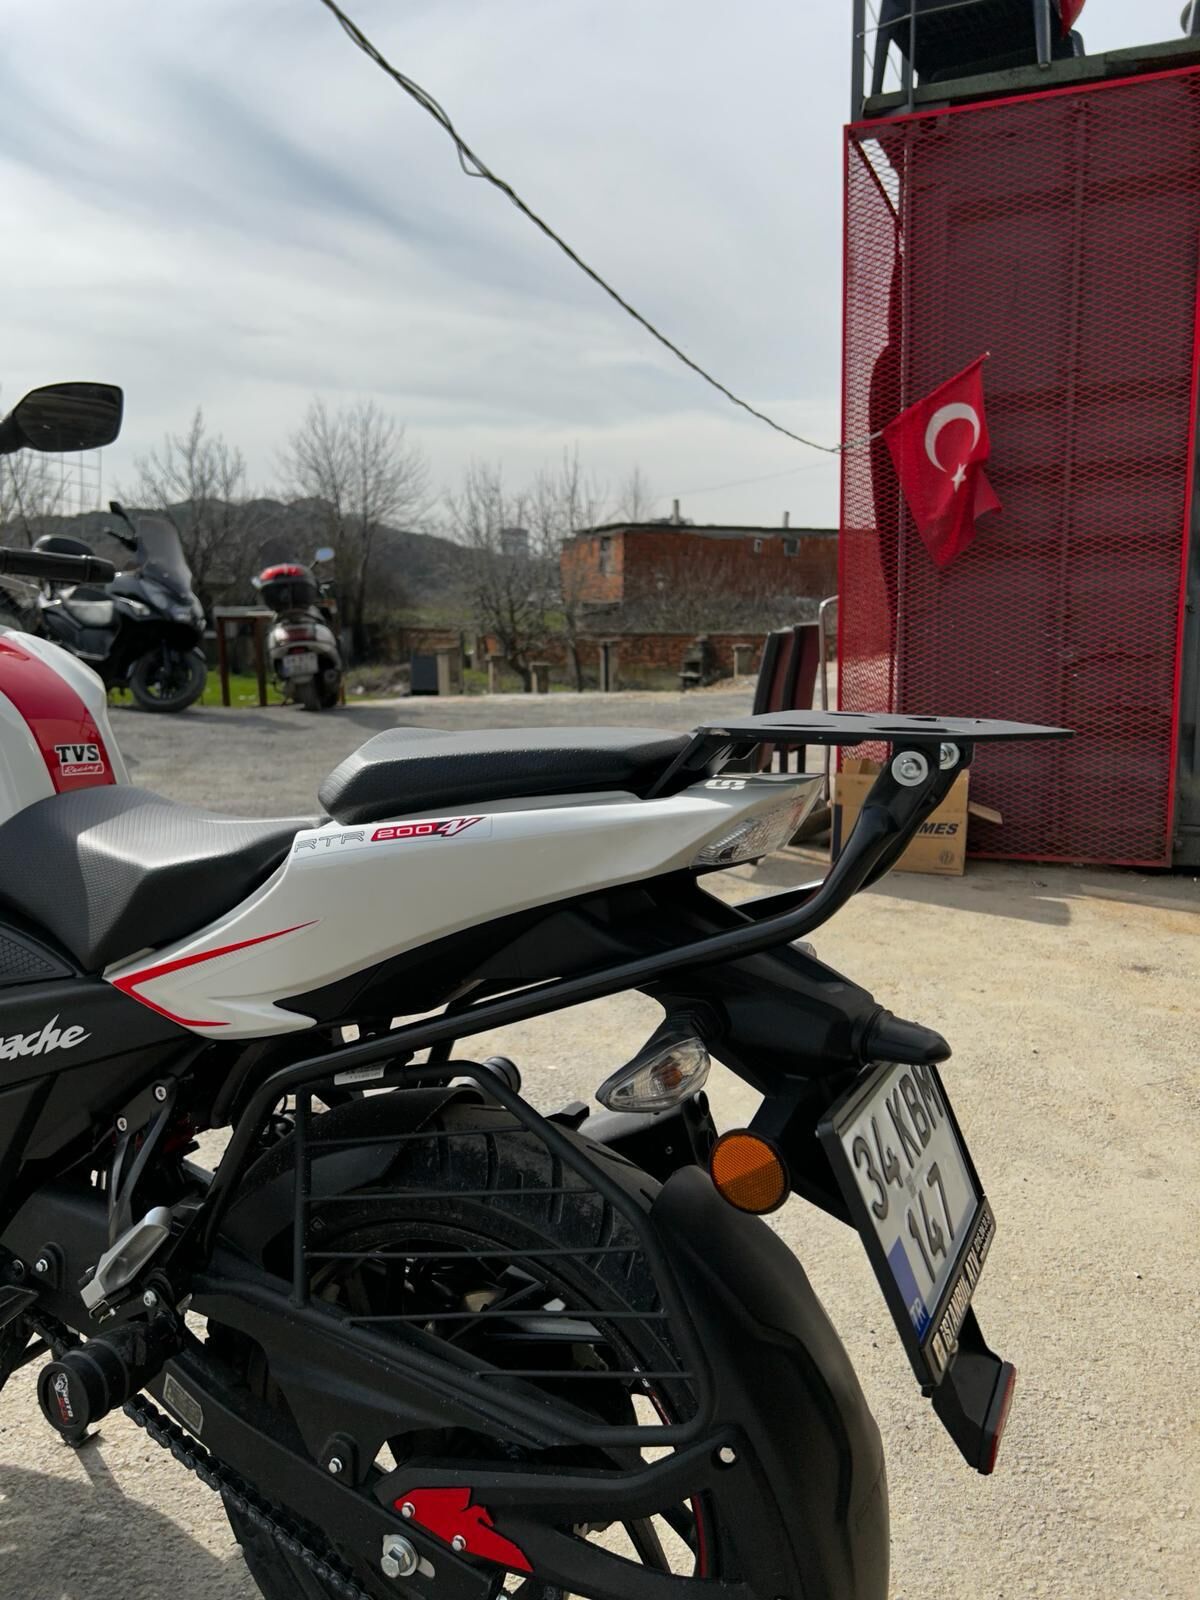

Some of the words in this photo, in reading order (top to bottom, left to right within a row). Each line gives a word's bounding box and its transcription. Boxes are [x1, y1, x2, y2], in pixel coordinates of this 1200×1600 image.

[55, 745, 100, 763] TVS
[294, 829, 366, 853] RTR
[377, 825, 433, 839] 200
[438, 816, 484, 837] 4V
[919, 822, 959, 836] MES
[852, 1115, 904, 1221] 34
[886, 1064, 944, 1169] KBM
[907, 1161, 955, 1285] 147
[910, 1297, 927, 1332] TR
